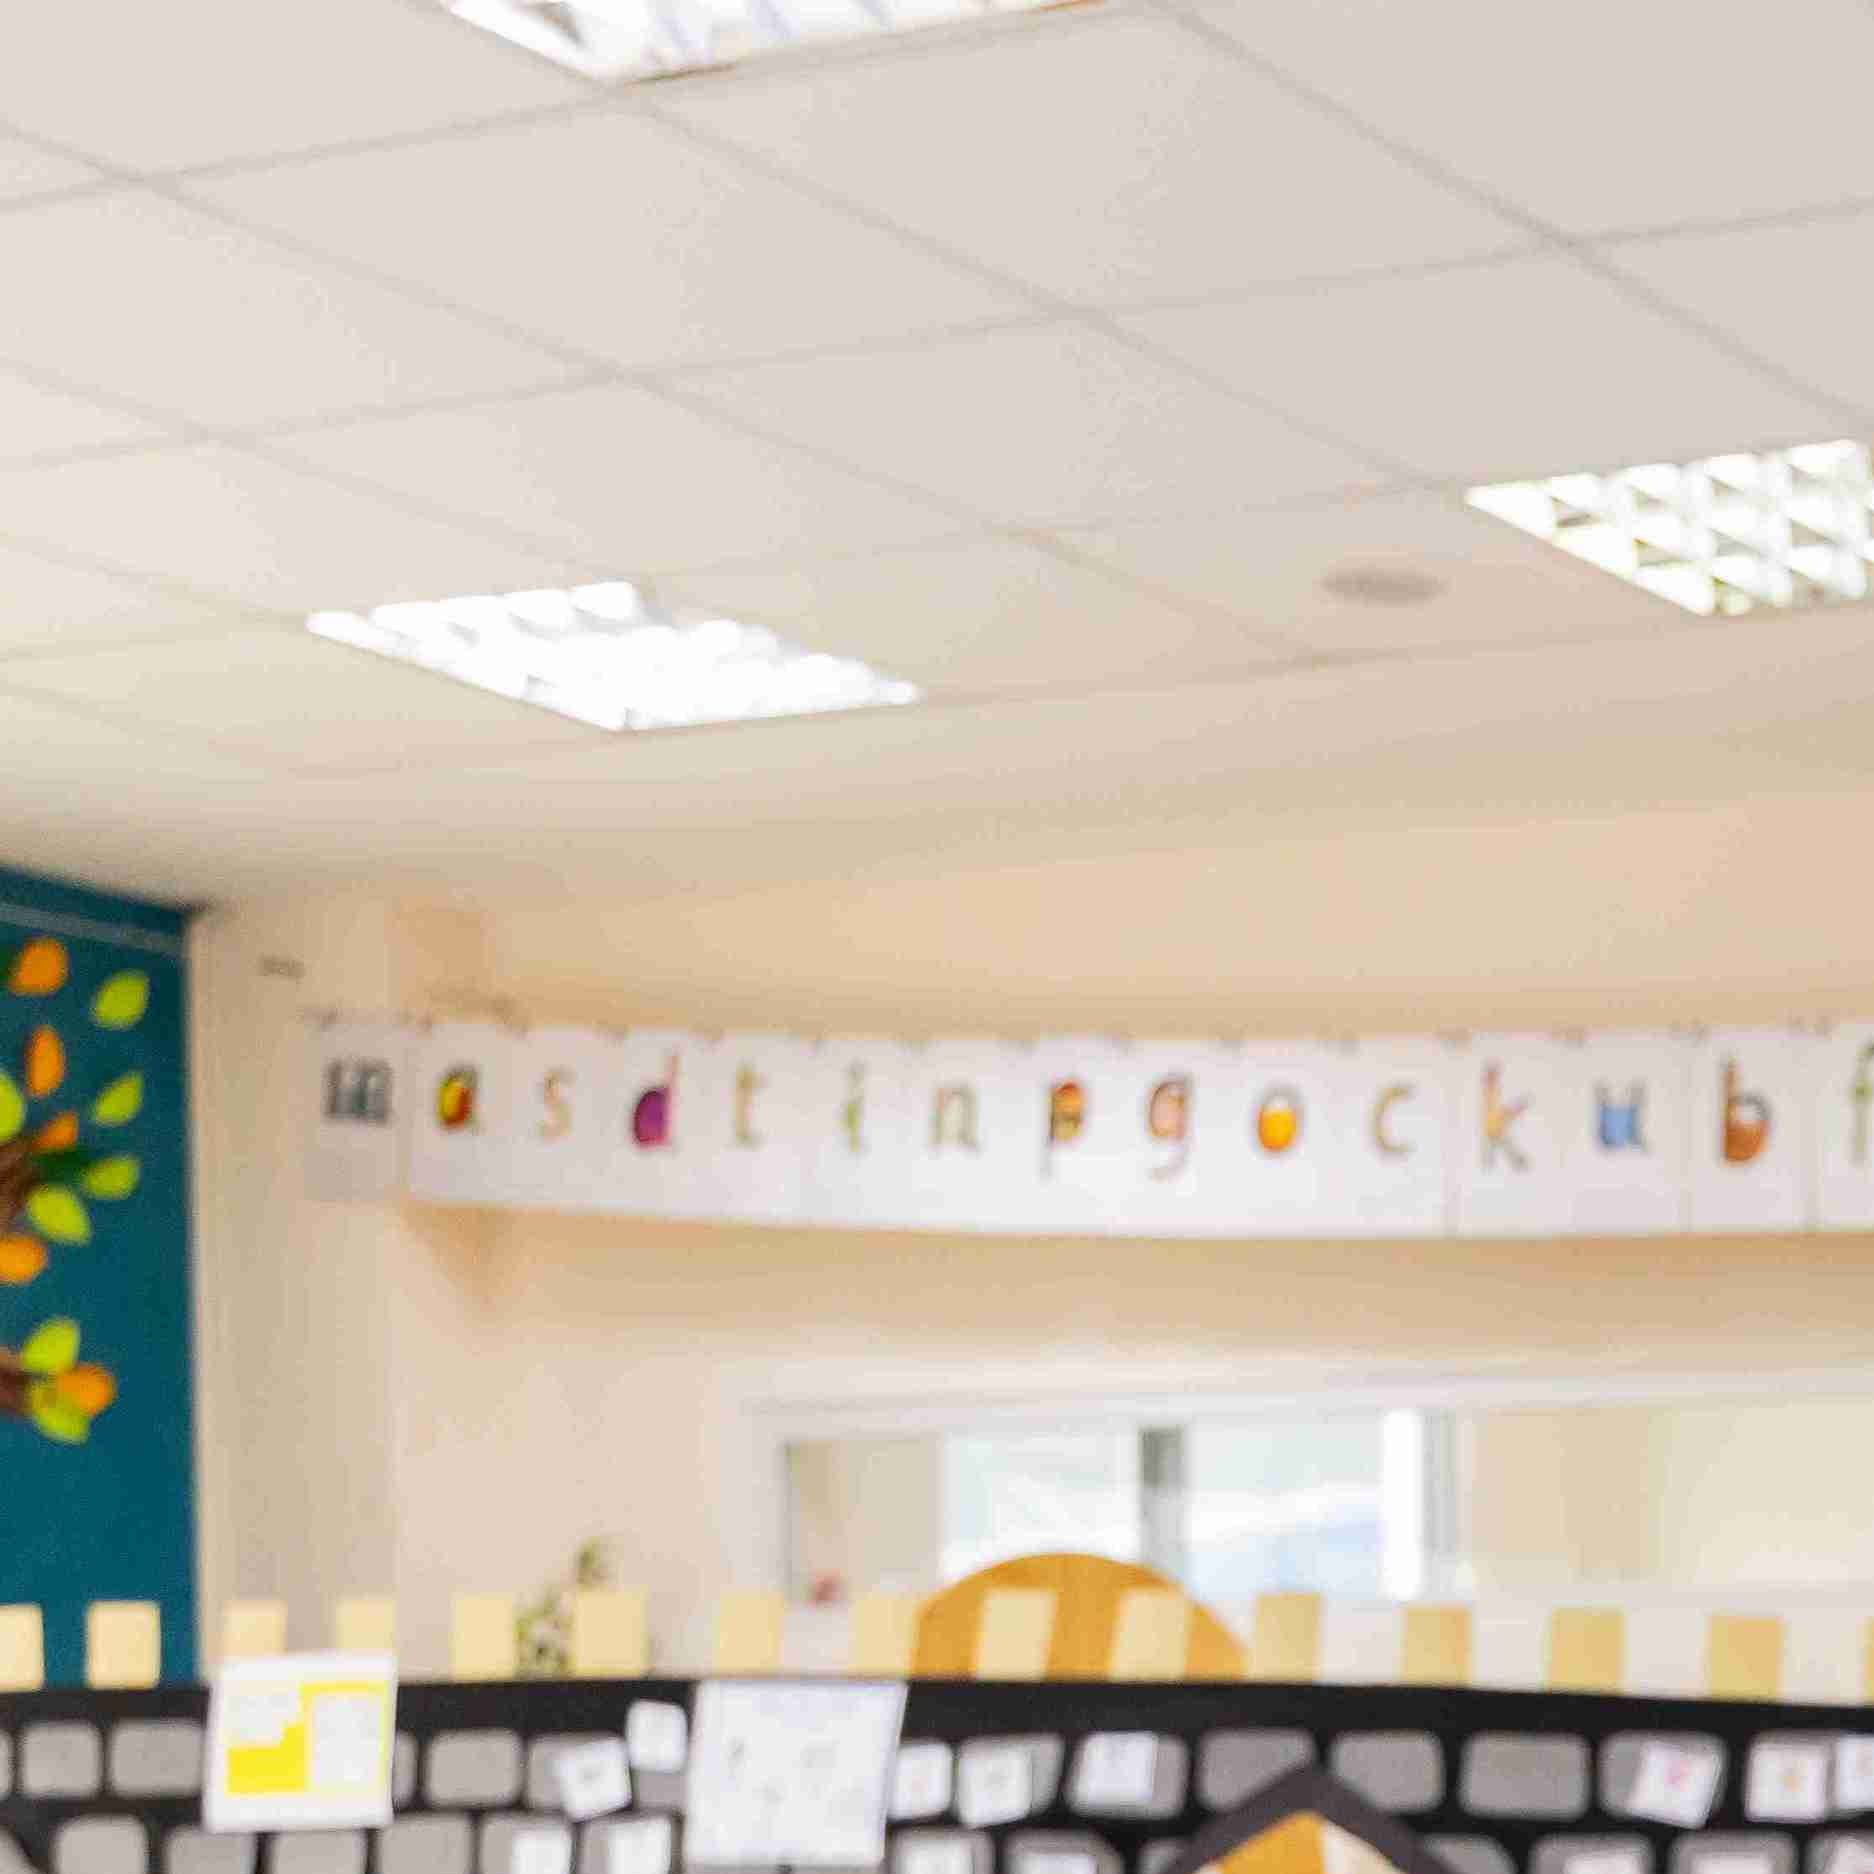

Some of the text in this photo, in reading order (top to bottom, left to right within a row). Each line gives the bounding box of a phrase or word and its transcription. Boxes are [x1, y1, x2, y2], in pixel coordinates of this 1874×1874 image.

[436, 1063, 481, 1133] a
[537, 1067, 576, 1139] s
[630, 1051, 681, 1150] d
[731, 1064, 765, 1148] t
[930, 1074, 981, 1154] n
[1038, 1079, 1086, 1179] p
[1146, 1074, 1195, 1181] g
[1255, 1085, 1302, 1155] o
[1369, 1082, 1416, 1157] c
[1477, 1060, 1531, 1172] k
[1598, 1079, 1650, 1155] u
[1720, 1052, 1773, 1165] b
